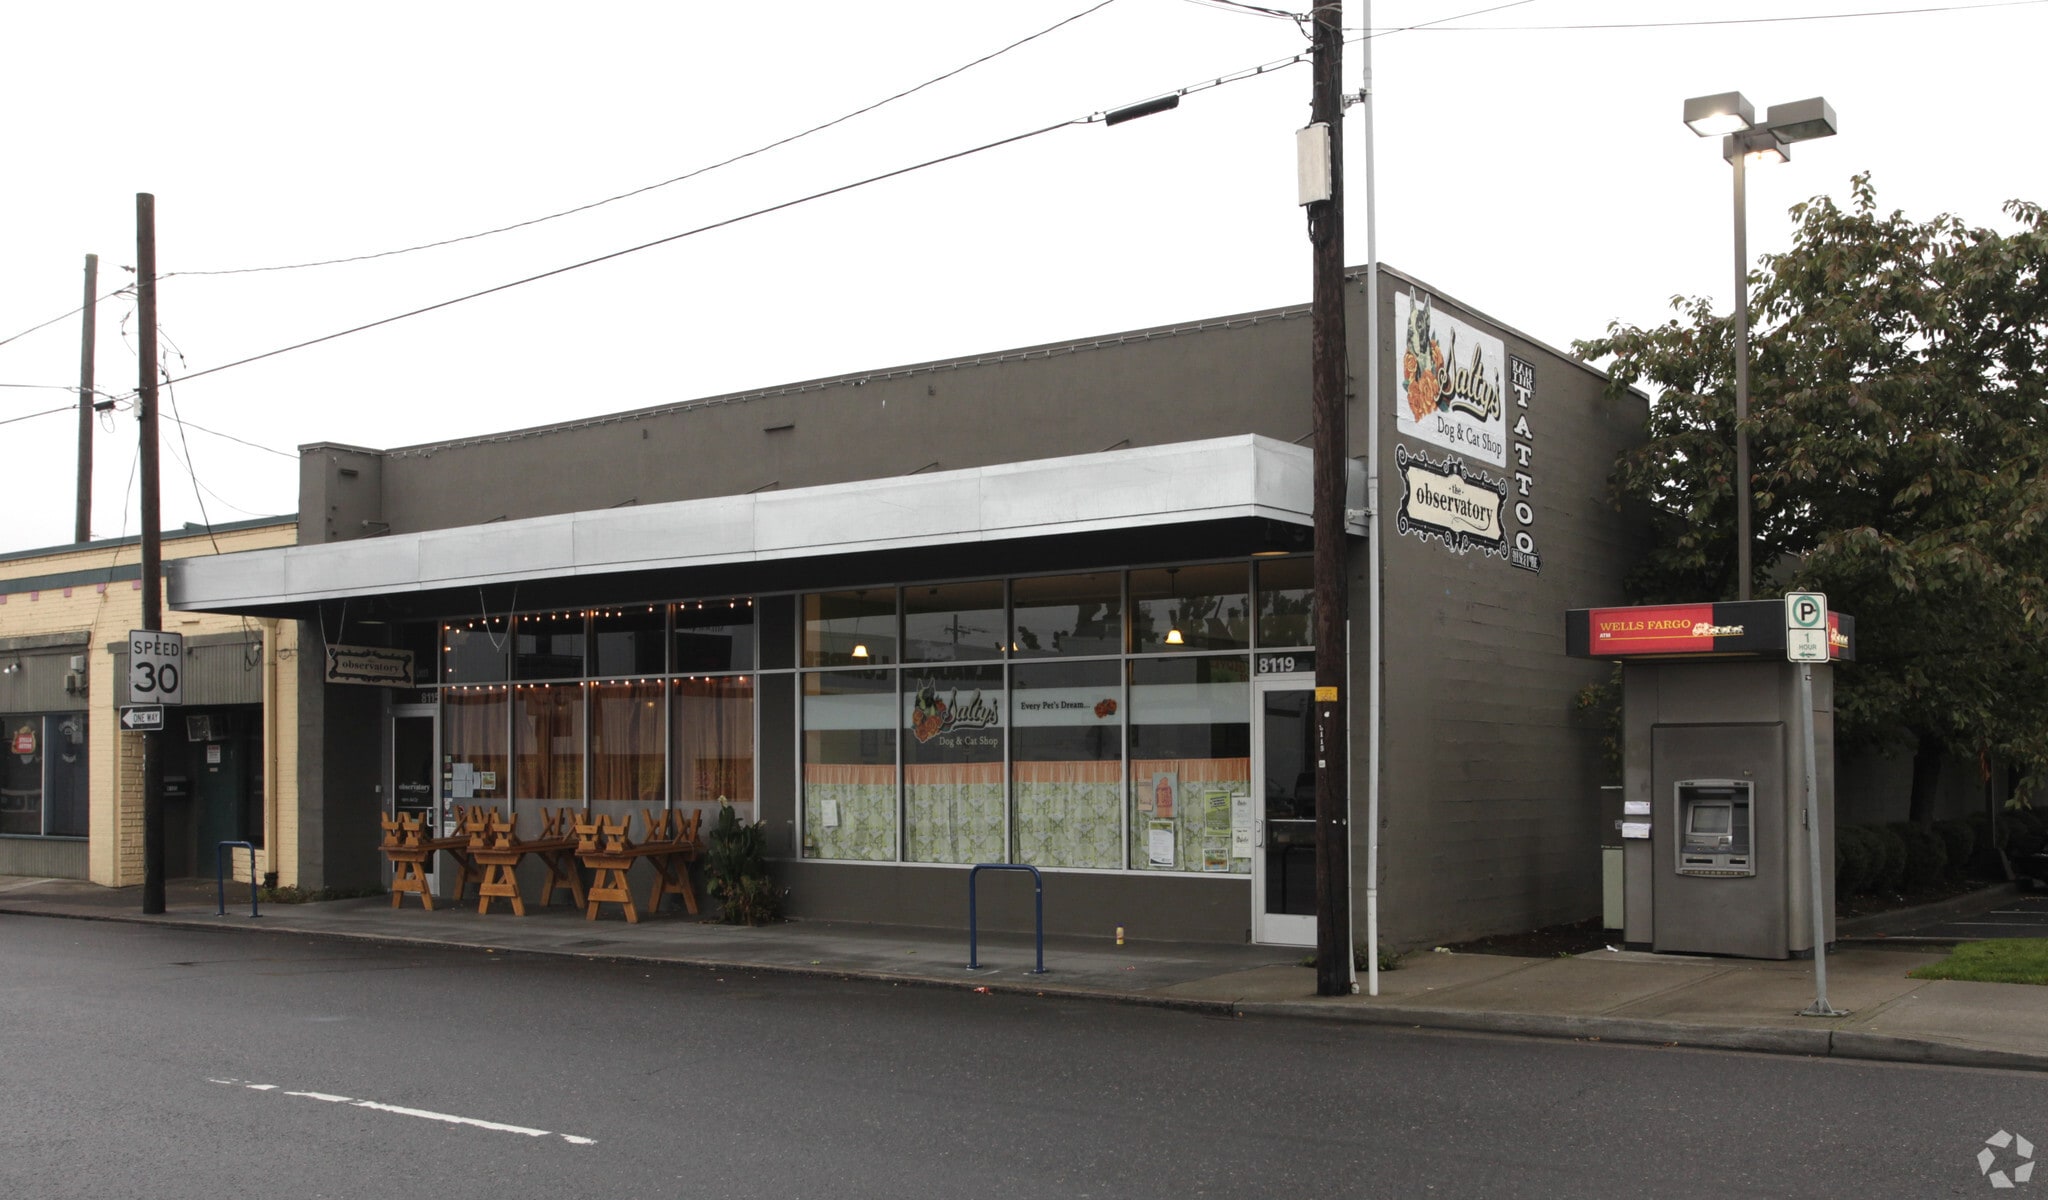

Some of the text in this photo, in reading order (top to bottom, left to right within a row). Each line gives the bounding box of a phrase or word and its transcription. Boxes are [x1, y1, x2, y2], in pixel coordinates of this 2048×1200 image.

[1434, 326, 1500, 422] Salty's
[1437, 416, 1502, 459] Dog & Cat Shop
[1513, 384, 1534, 554] TATTOO
[1451, 485, 1462, 496] the
[1416, 483, 1494, 531] observatory
[1800, 602, 1815, 621] P
[1600, 619, 1692, 632] WELLS FARGO
[1804, 632, 1810, 643] 1
[134, 640, 179, 657] SPEED
[342, 659, 400, 673] observatory
[1259, 656, 1295, 673] 8119
[134, 661, 179, 694] 30
[941, 686, 999, 730] Salty's
[1020, 702, 1041, 711] Every
[1042, 701, 1060, 709] Pet's
[133, 712, 159, 723] ONE WAY
[939, 735, 999, 748] Dog & Cat Shop
